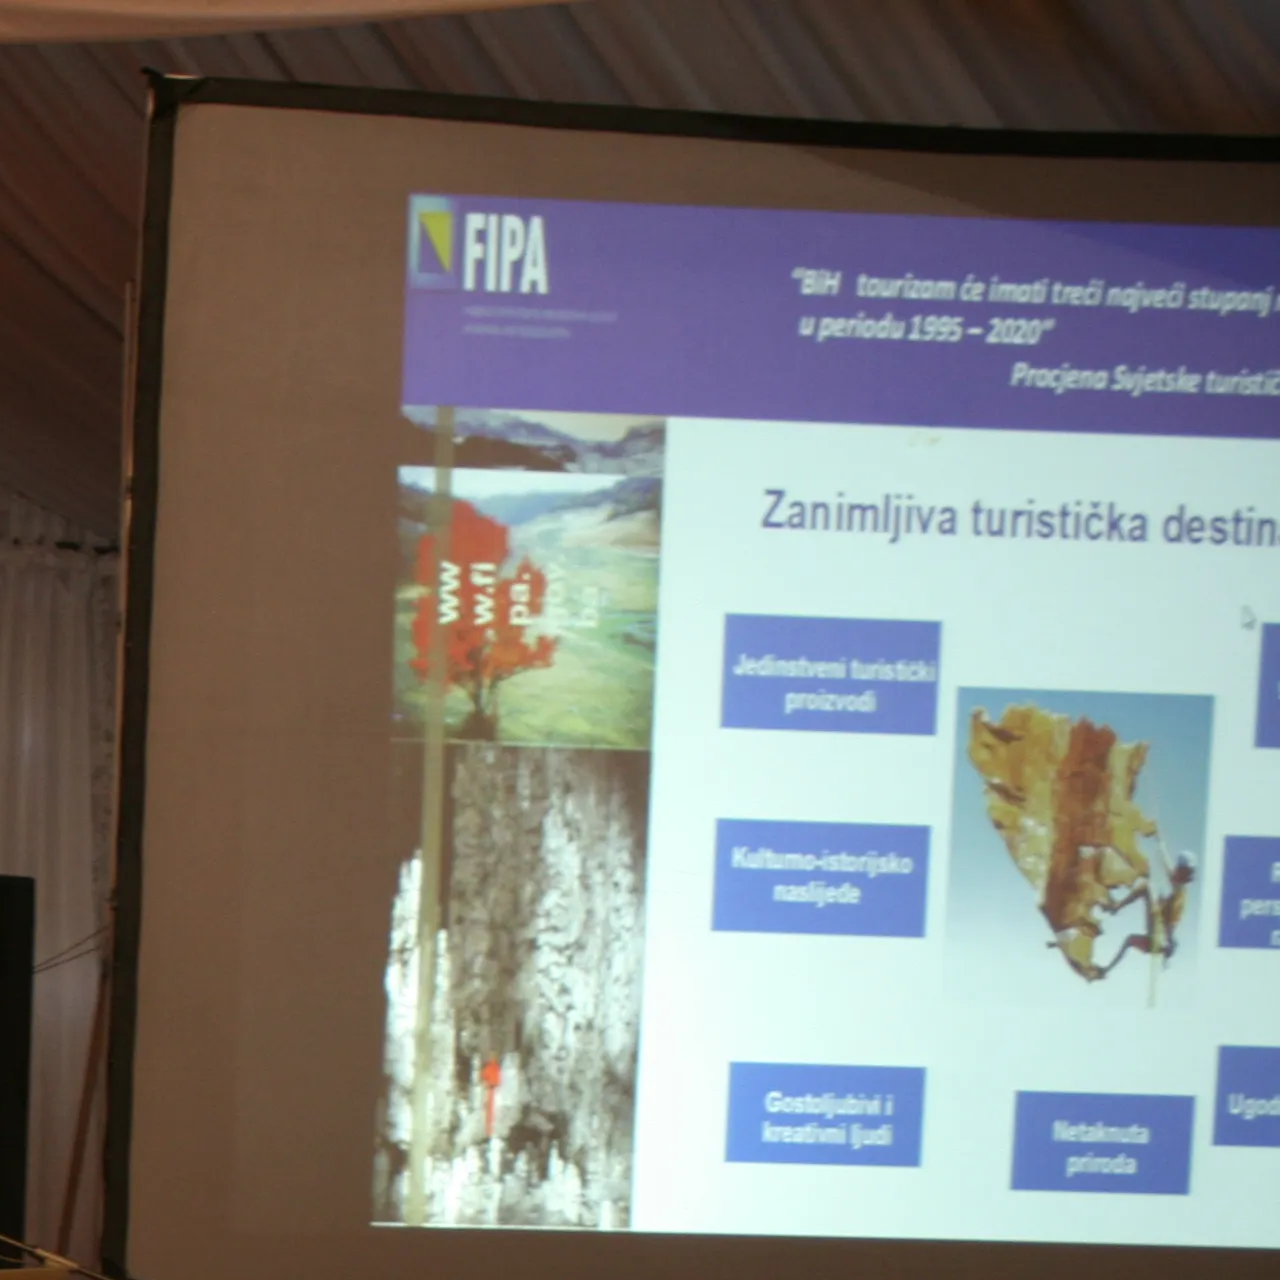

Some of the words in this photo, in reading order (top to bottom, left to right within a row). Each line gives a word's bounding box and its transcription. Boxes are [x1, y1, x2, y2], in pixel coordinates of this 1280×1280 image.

[462, 212, 549, 294] FIPA
[960, 273, 986, 302] će
[988, 275, 1050, 304] imati
[1051, 279, 1105, 306] treći
[1106, 281, 1187, 313] najveći
[1188, 285, 1274, 317] stupanj
[799, 316, 816, 336] u
[816, 312, 907, 343] periodu
[908, 314, 965, 342] 1995
[1010, 361, 1109, 395] Procjena
[1111, 365, 1202, 397] Svjetske
[761, 488, 958, 544] Zanimljiva
[972, 499, 1149, 543] turistička
[1163, 503, 1280, 547] destin
[732, 653, 847, 680] Jedinstveni
[851, 656, 937, 682] turistički
[783, 688, 878, 715] proizvodi
[764, 1090, 882, 1120] Gostoljubivi
[884, 1093, 895, 1116] i
[762, 1121, 847, 1144] kreativni
[849, 1122, 894, 1150] ljudi
[1052, 1119, 1151, 1145] Netaknuta
[1066, 1152, 1138, 1178] priroda
